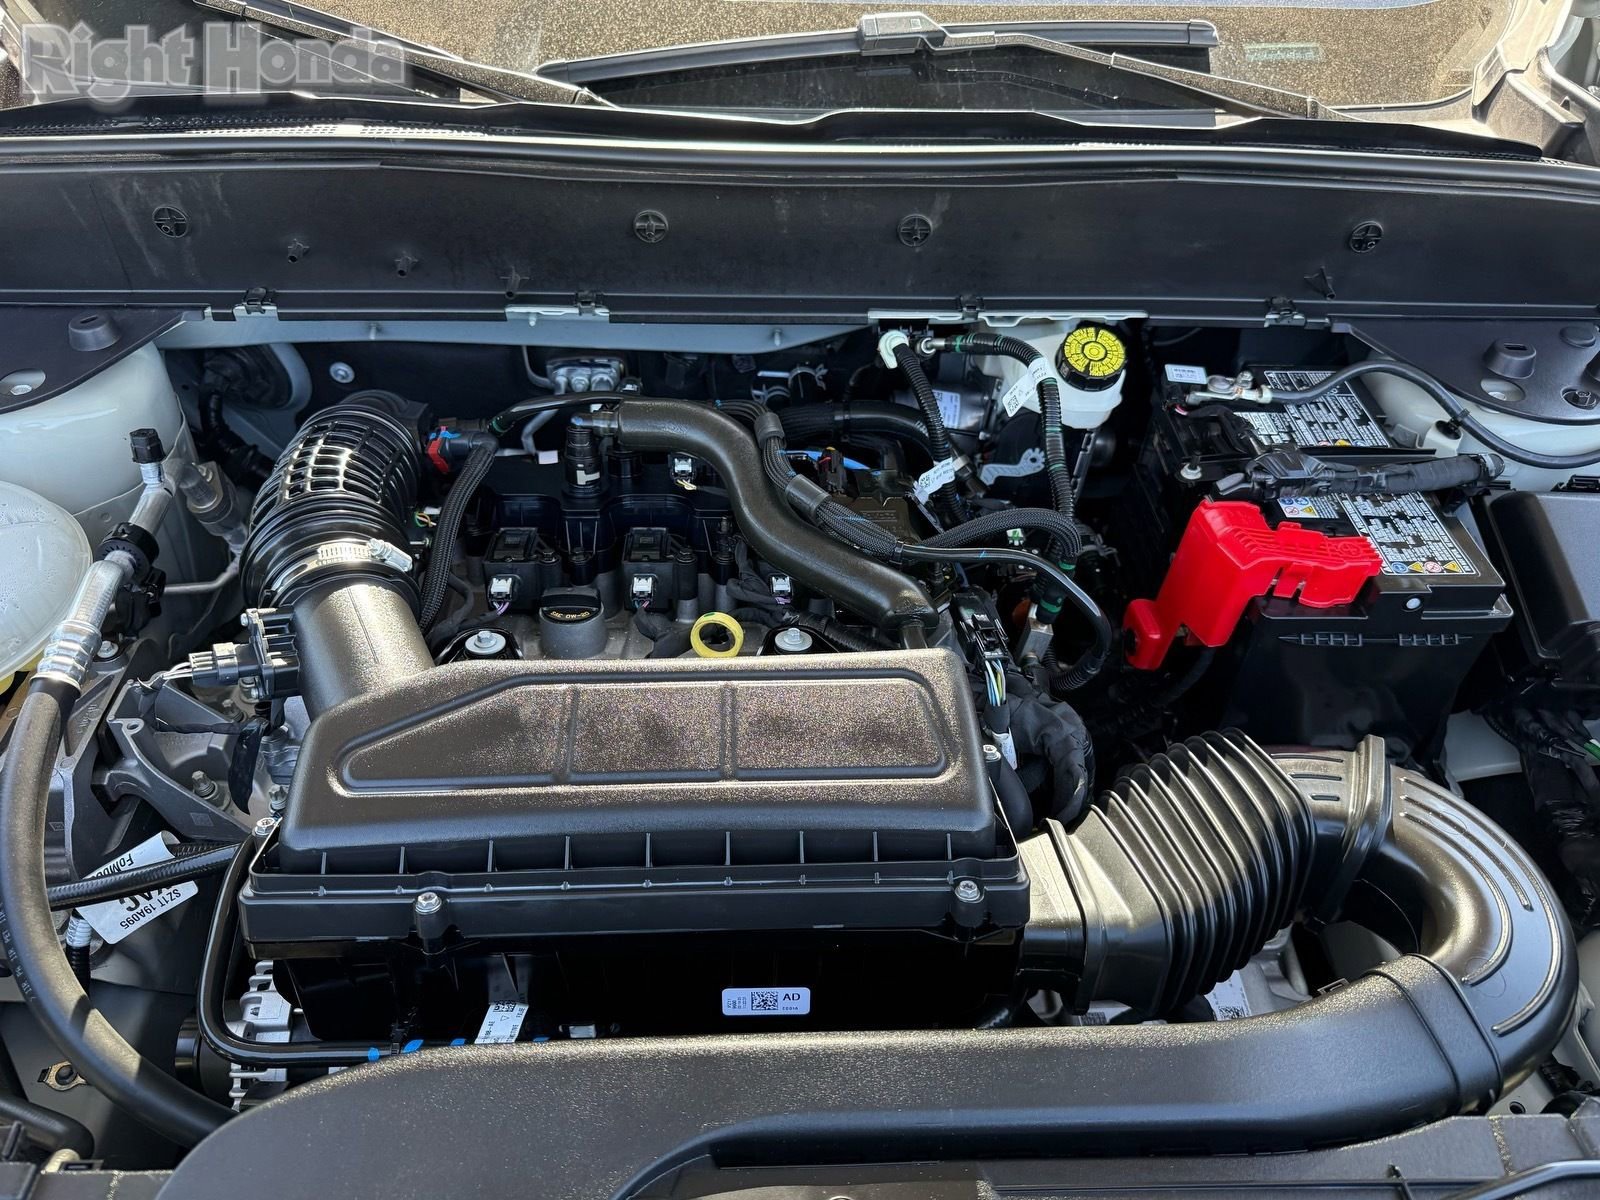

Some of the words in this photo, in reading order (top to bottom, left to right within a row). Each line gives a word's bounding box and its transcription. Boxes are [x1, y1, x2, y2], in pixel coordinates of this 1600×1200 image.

[91, 853, 134, 878] FoMo
[160, 888, 181, 907] SZ1T
[119, 902, 157, 930] 19A095
[782, 992, 801, 1001] AD
